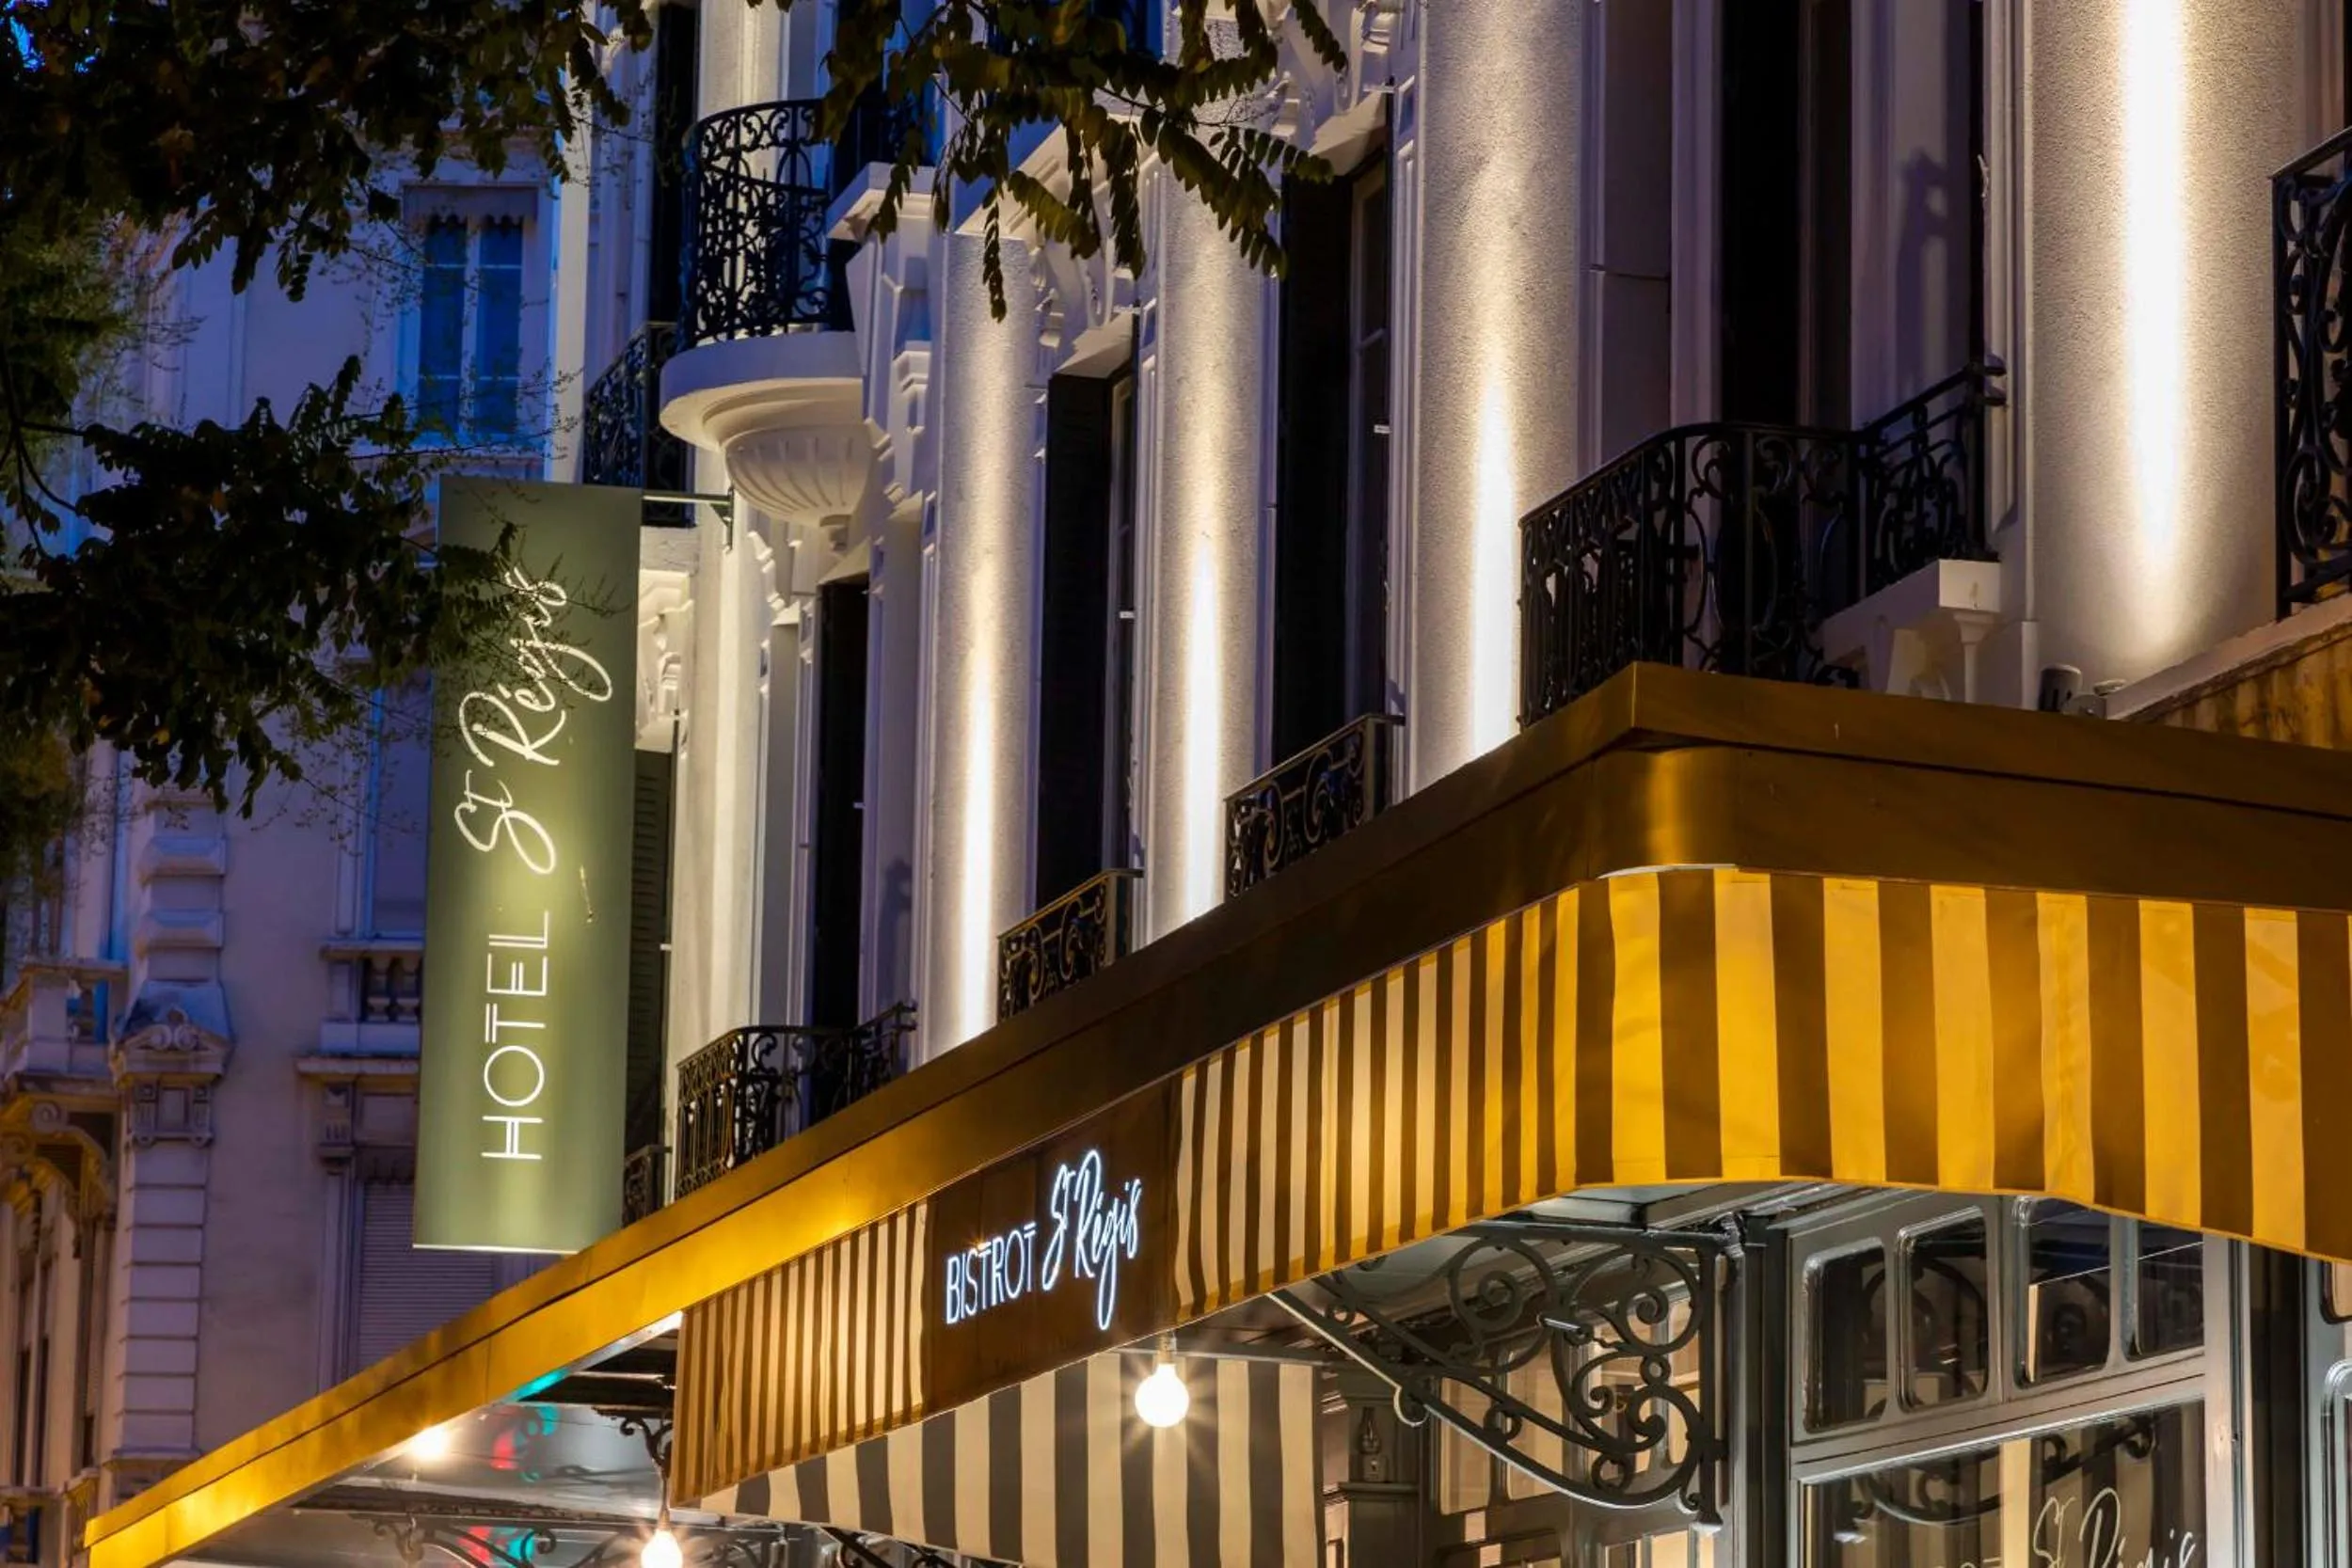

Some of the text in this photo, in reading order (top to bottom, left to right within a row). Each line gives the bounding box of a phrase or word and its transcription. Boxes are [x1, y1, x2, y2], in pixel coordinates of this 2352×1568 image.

[481, 911, 548, 1160] HOTEL
[946, 1221, 1038, 1325] BISTROT
[1074, 1149, 1142, 1331] Régis
